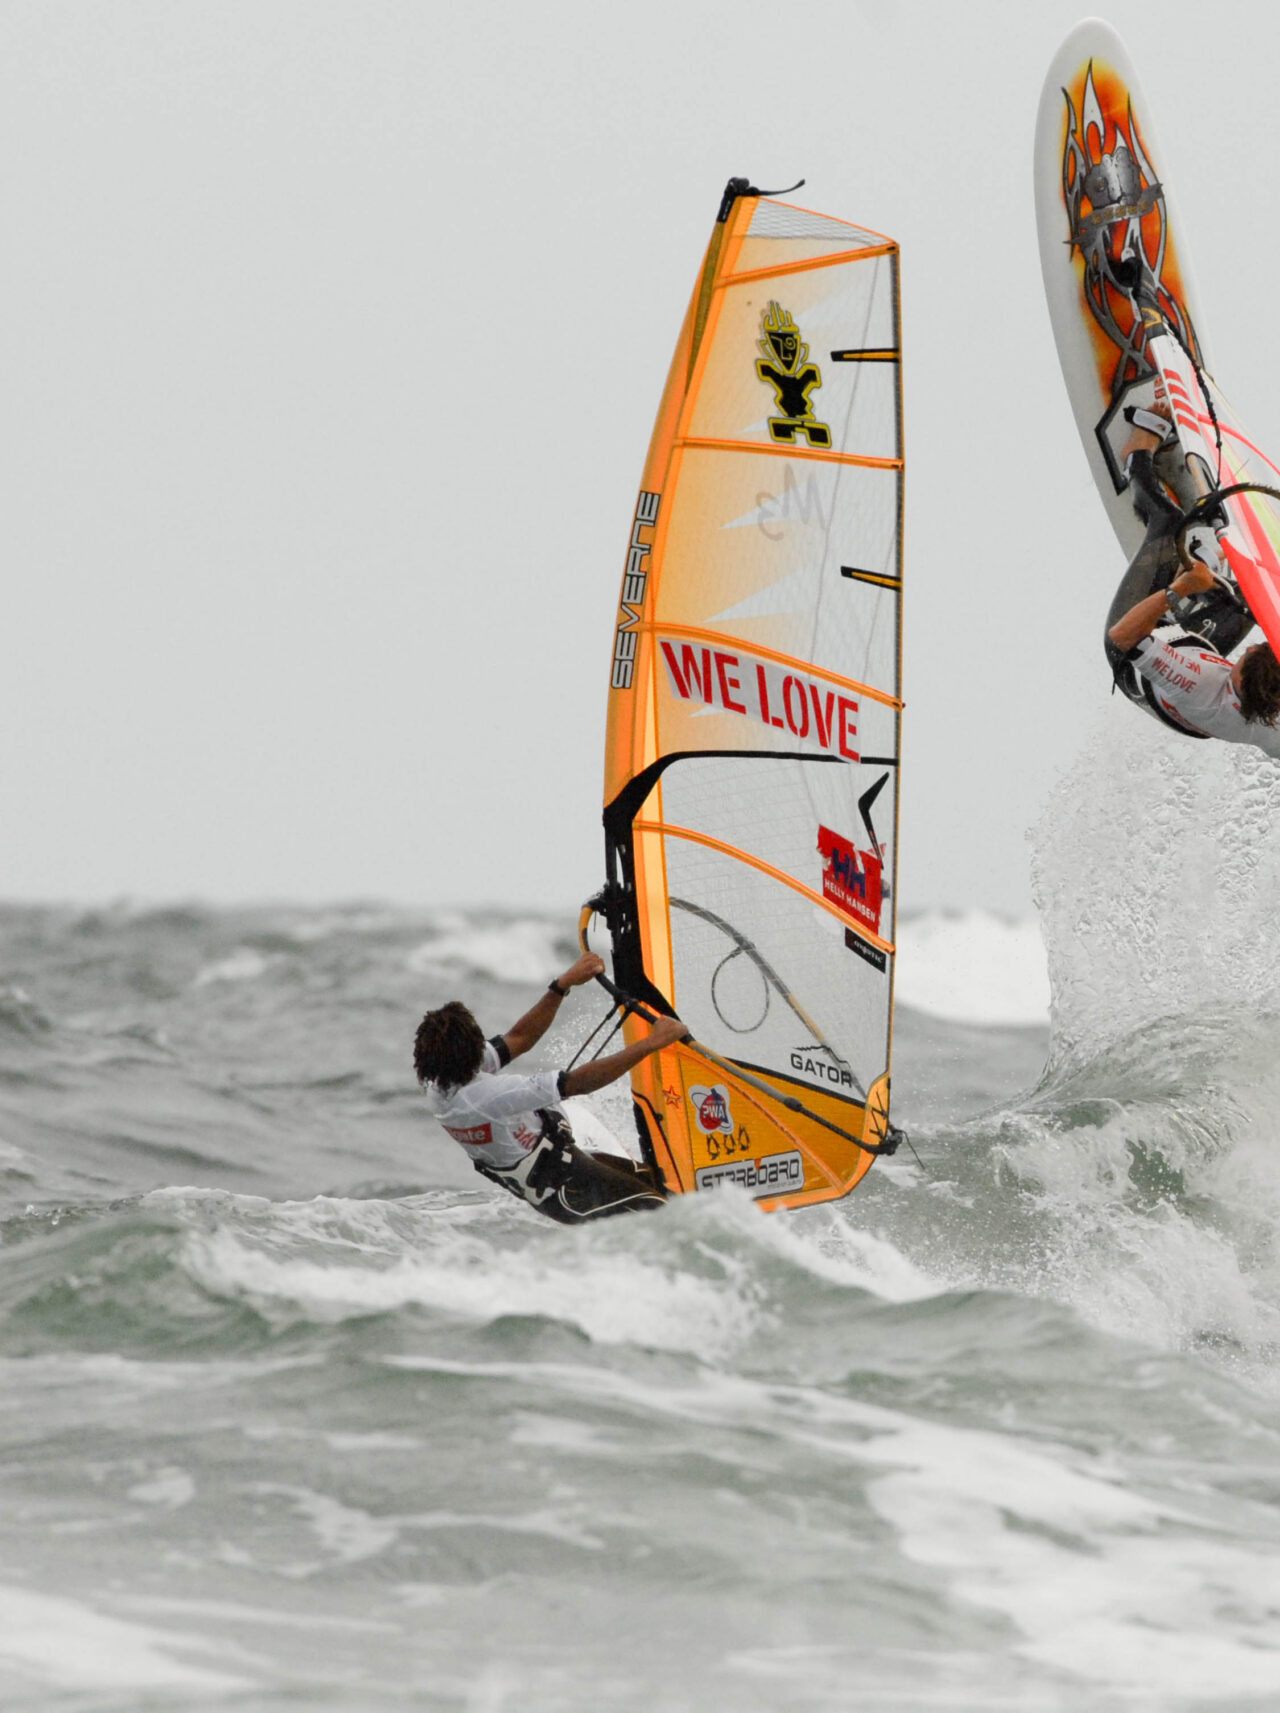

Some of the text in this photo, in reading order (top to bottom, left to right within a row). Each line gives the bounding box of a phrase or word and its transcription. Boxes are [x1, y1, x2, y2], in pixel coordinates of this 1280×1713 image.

[611, 490, 661, 689] SEVERNE
[1151, 657, 1198, 694] WE LOVE
[660, 641, 860, 763] WE LOVE
[824, 878, 876, 923] HELLY HANSEN
[790, 1053, 852, 1088] GATOR
[703, 1104, 726, 1120] PWA
